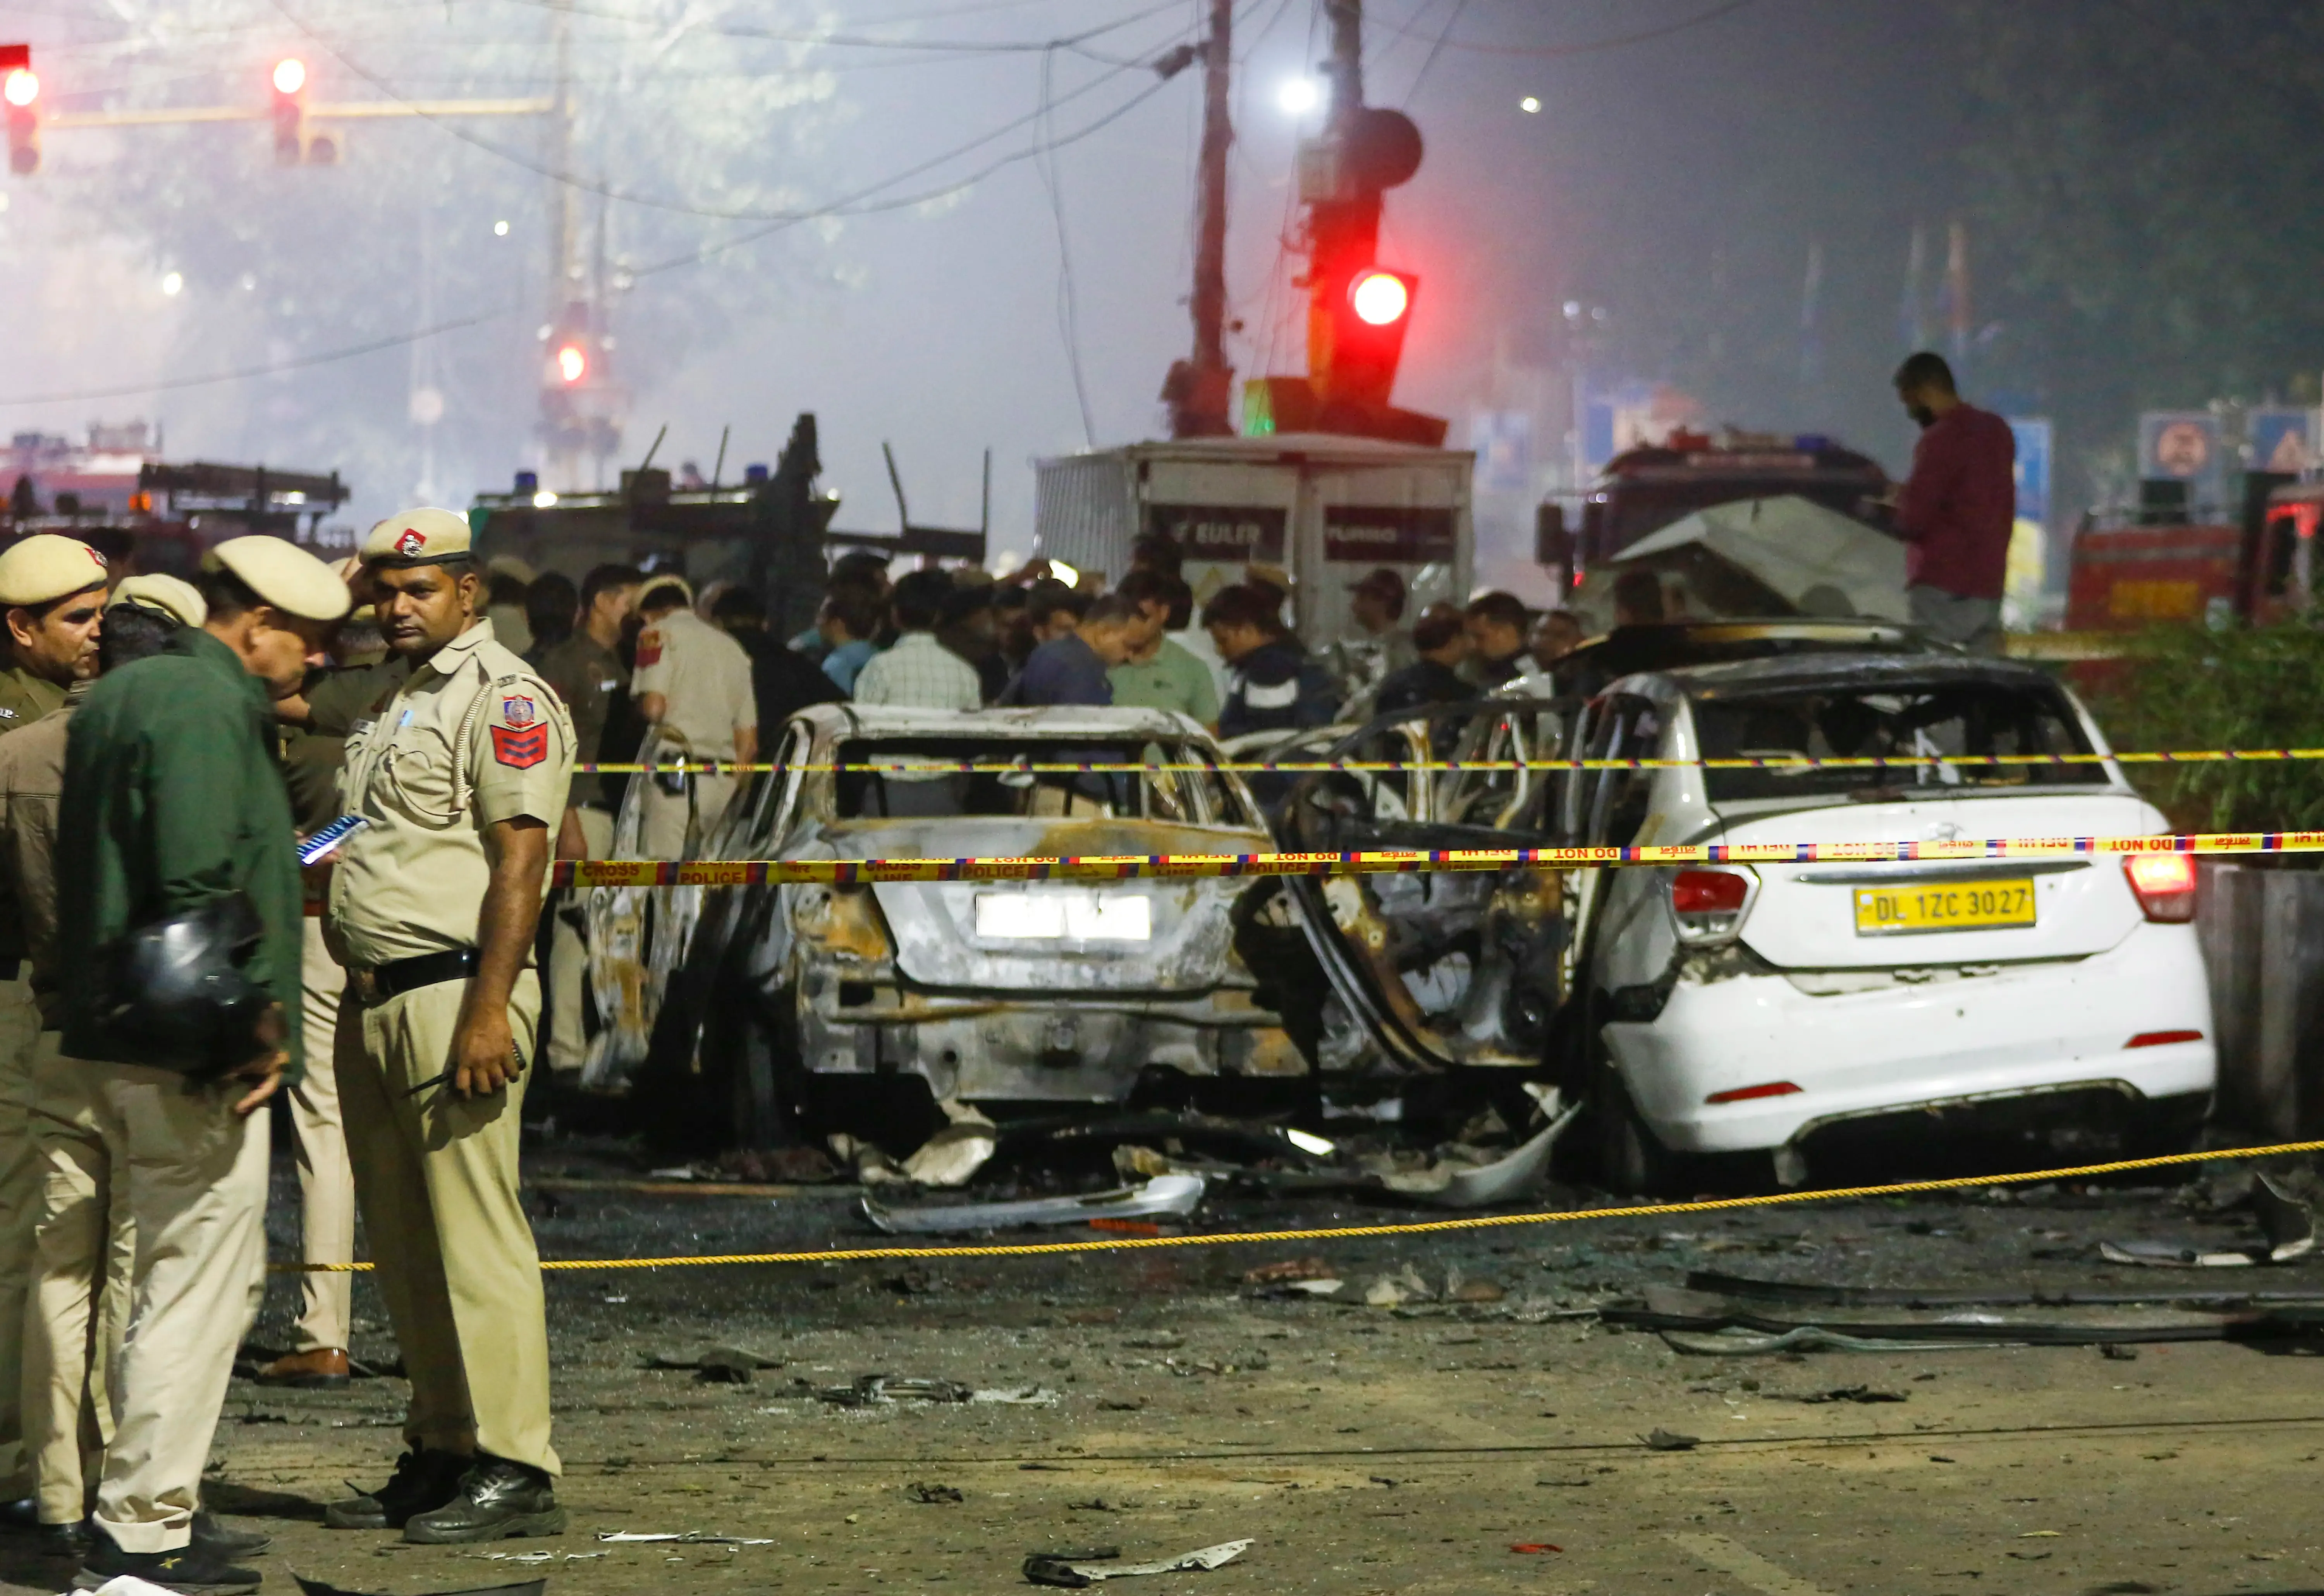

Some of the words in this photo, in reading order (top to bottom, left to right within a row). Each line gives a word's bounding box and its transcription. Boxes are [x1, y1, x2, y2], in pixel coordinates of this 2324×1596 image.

[1196, 522, 1260, 543] EULER
[1833, 843, 1866, 856] NOT
[2110, 840, 2144, 851] NOT
[2150, 839, 2172, 850] DO
[1554, 849, 1588, 858] NOT
[1595, 848, 1617, 858] DO
[582, 864, 640, 877] CROSS
[963, 864, 1026, 878] POLICE
[1245, 862, 1307, 873] POLICE
[680, 872, 743, 885] POLICE
[1877, 896, 1906, 921] DL
[1916, 893, 1958, 918] 1ZC
[1967, 888, 2026, 915] 3027
